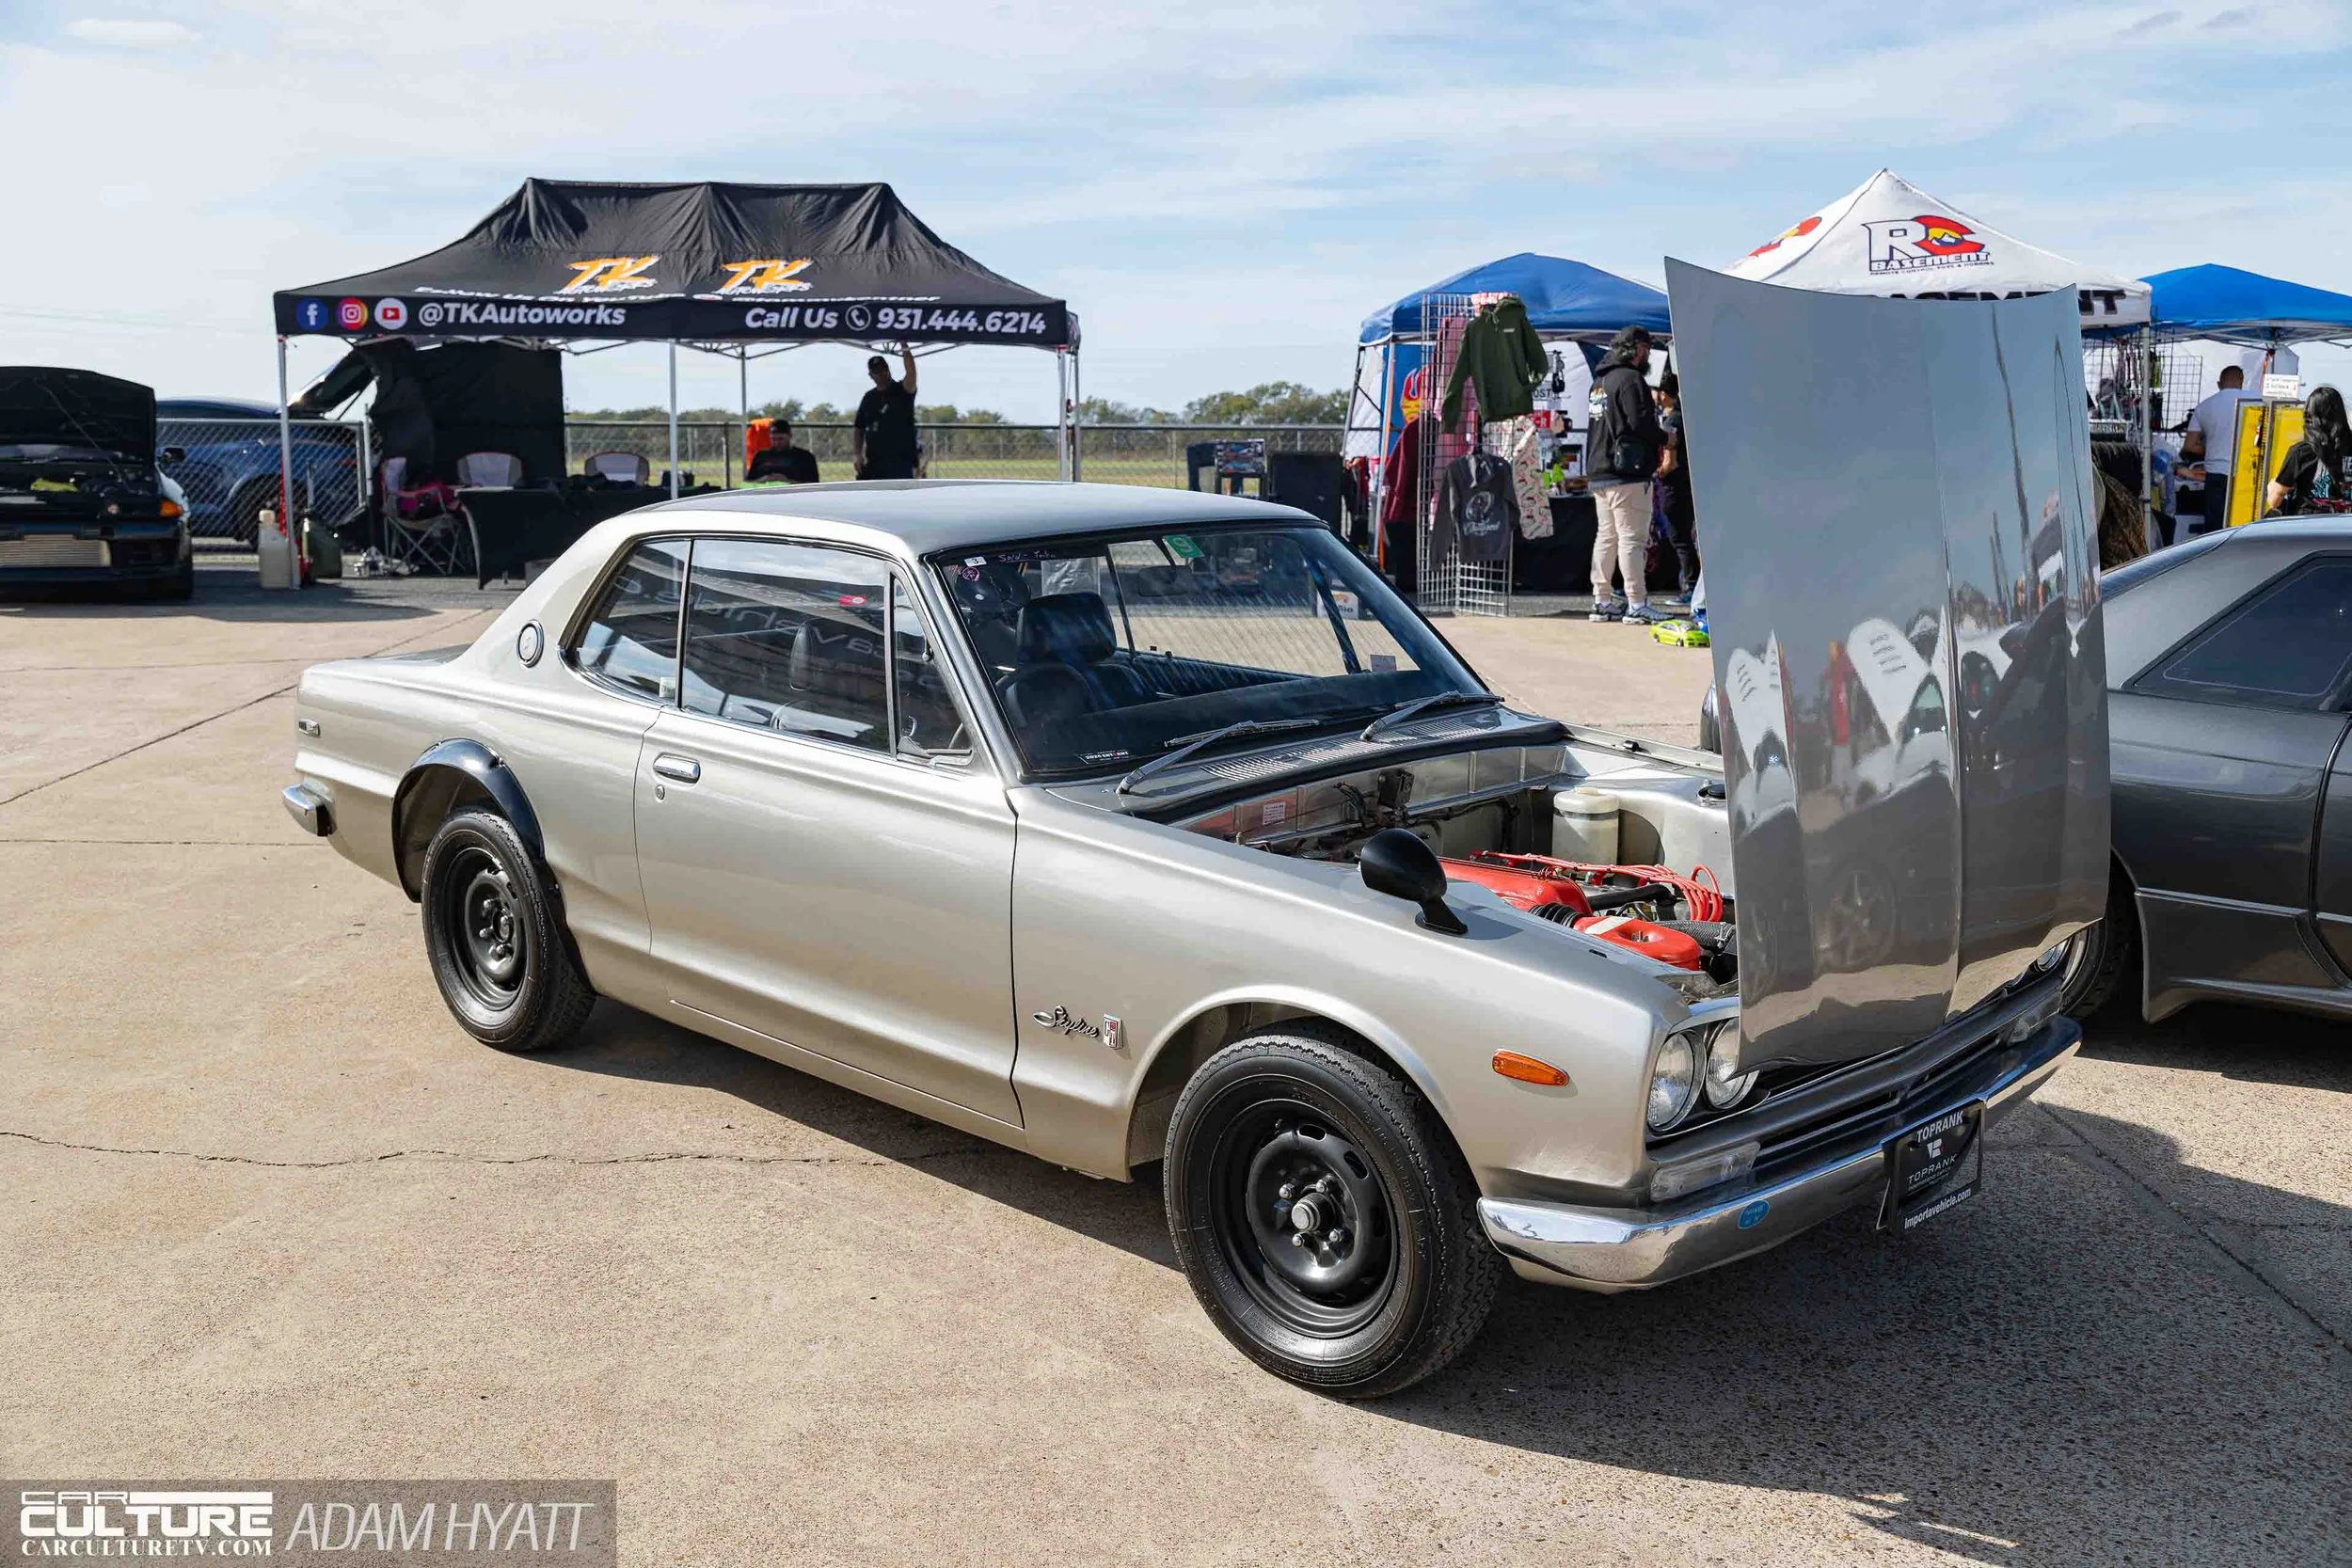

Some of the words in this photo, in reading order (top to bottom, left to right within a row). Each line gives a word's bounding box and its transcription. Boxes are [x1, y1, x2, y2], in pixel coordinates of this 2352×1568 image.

[562, 255, 661, 291] TK
[719, 257, 814, 290] TK
[1868, 251, 1991, 272] BASEMENT
[418, 302, 627, 326] @TKAutoworks
[745, 307, 800, 329] Call
[803, 308, 839, 330] Us
[876, 307, 1046, 335] 931.444.6214
[1033, 1005, 1101, 1039] Skyline
[1916, 1110, 1964, 1144] TOPRANK
[1908, 1153, 1959, 1185] TOPRANK
[1903, 1187, 1972, 1230] importavehicle.com
